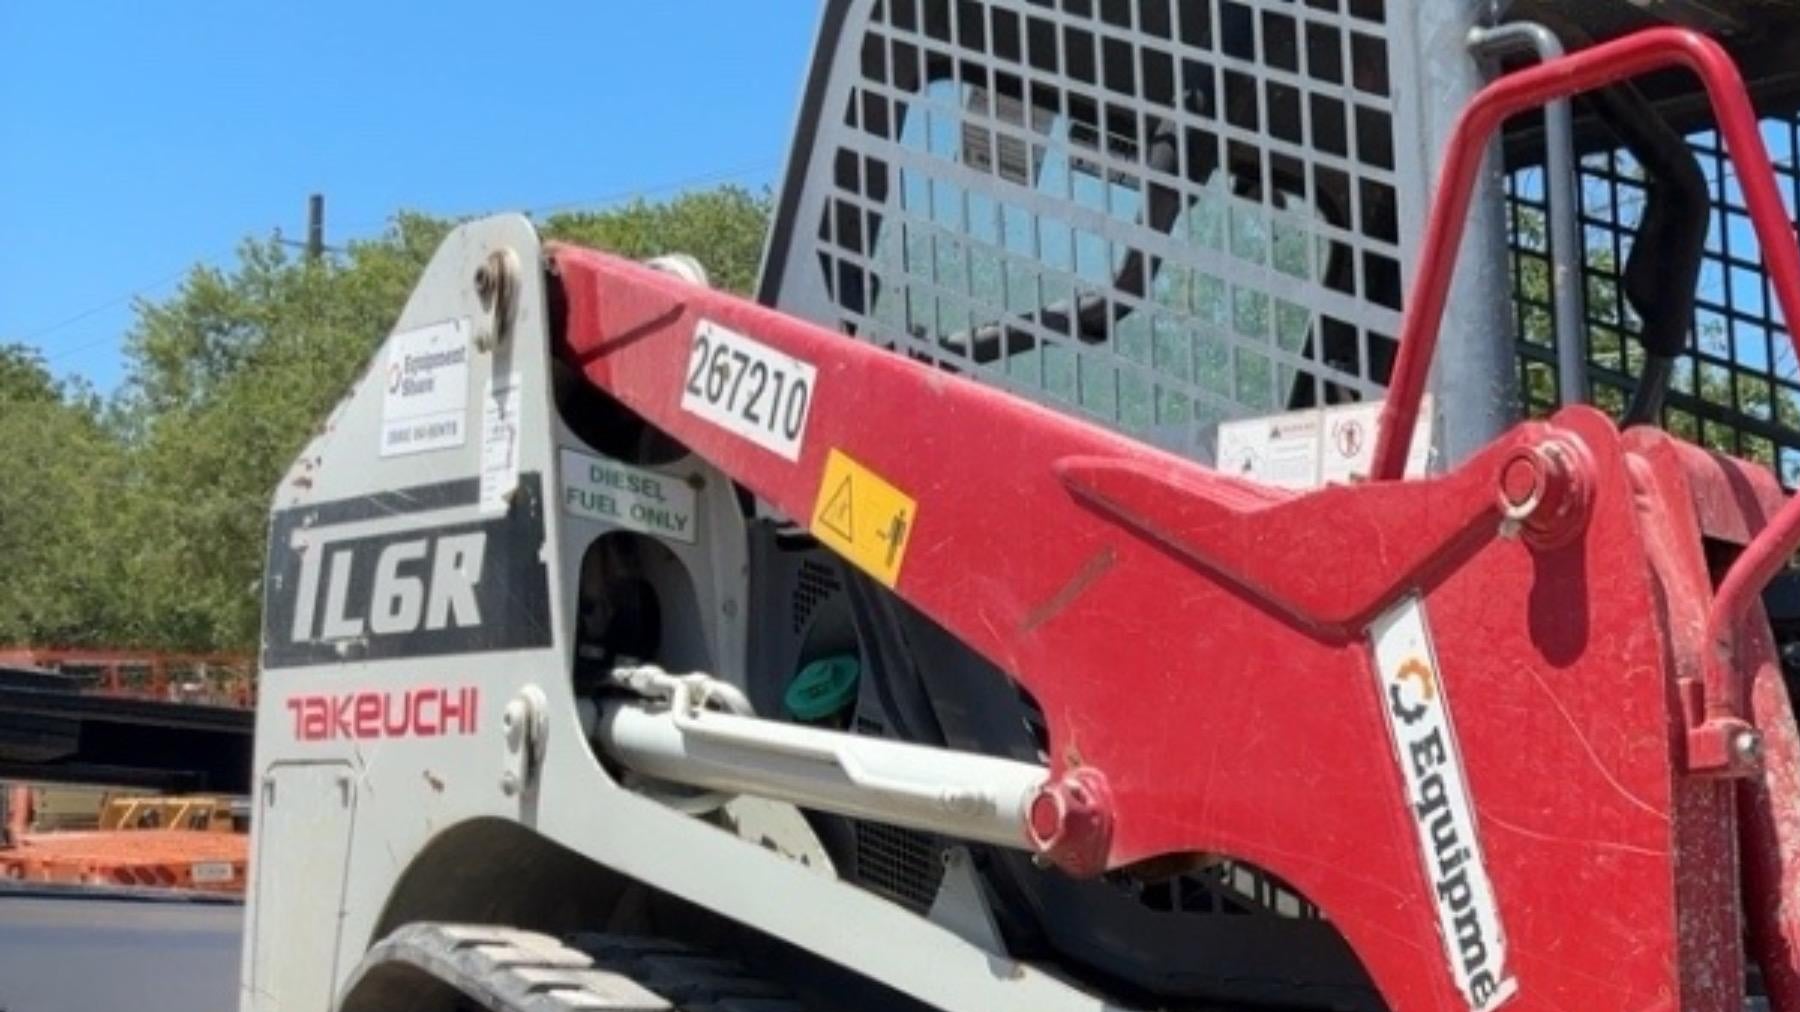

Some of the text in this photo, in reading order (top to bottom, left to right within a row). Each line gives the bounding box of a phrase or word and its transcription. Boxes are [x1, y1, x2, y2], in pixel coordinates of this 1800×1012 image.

[686, 334, 808, 441] 267210
[566, 487, 688, 531] FUEL ONLY
[590, 464, 666, 503] DIESEL
[290, 505, 508, 643] TL6R
